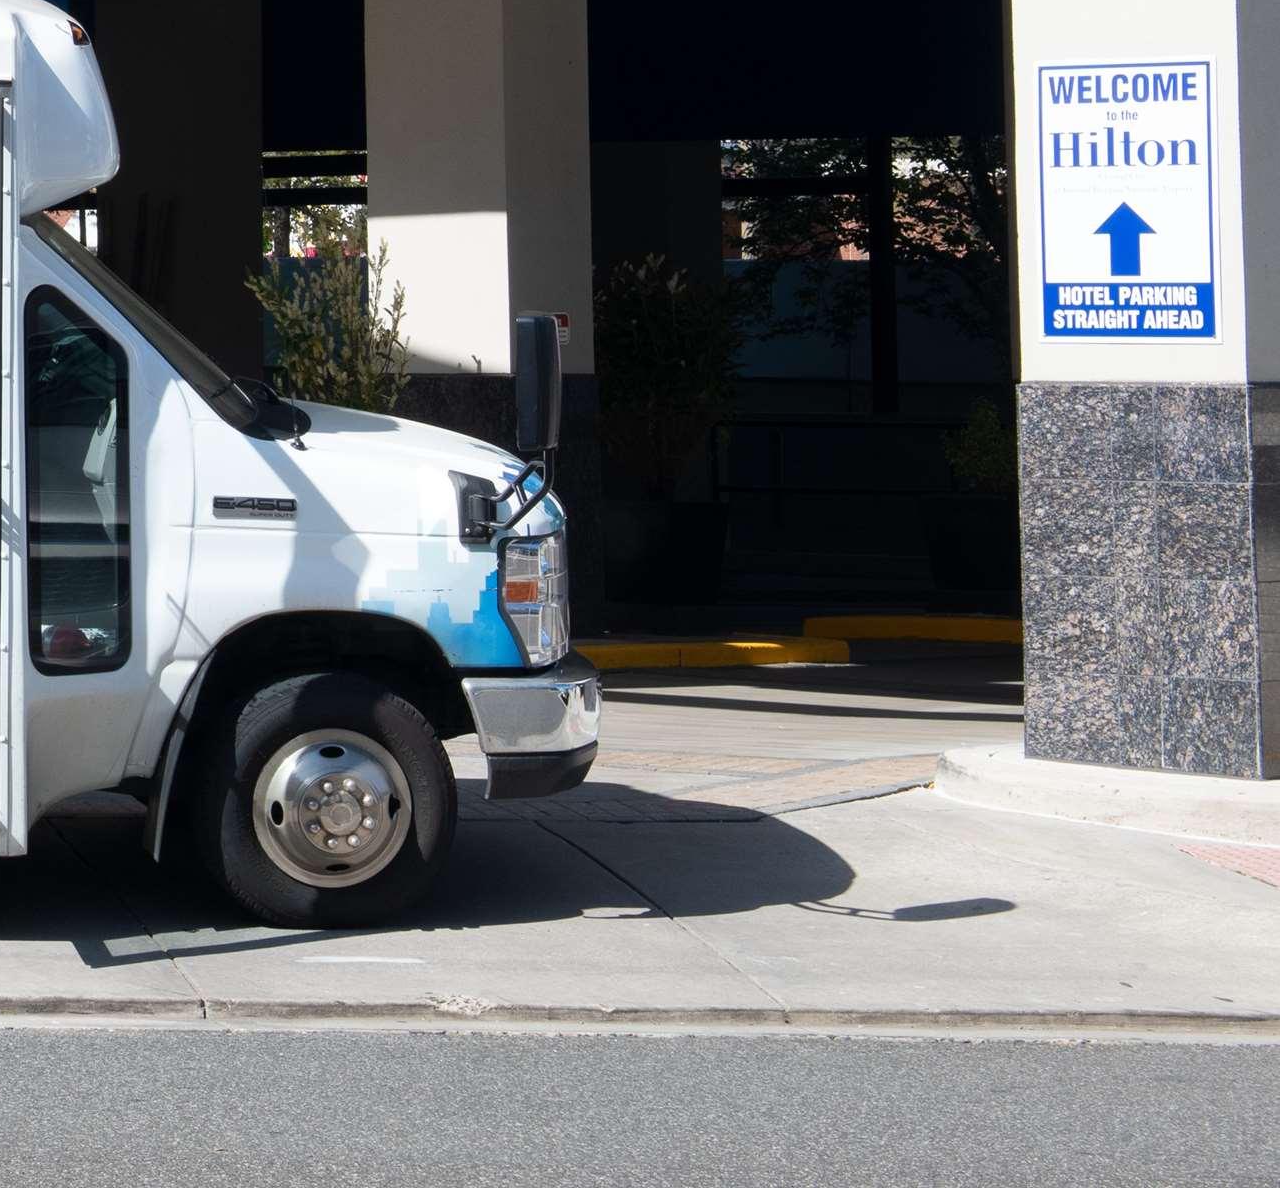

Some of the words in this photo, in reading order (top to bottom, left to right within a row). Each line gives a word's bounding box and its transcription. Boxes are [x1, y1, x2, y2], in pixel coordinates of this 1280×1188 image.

[1049, 72, 1197, 104] WELCOME
[1107, 111, 1117, 121] to
[1121, 110, 1138, 120] the
[1049, 126, 1201, 168] Hilton
[1059, 286, 1115, 306] HOTEL
[1119, 286, 1197, 306] PARKING
[1053, 310, 1141, 330] STRAIGHT
[1143, 310, 1204, 330] AHEAD
[213, 496, 297, 512] E-450
